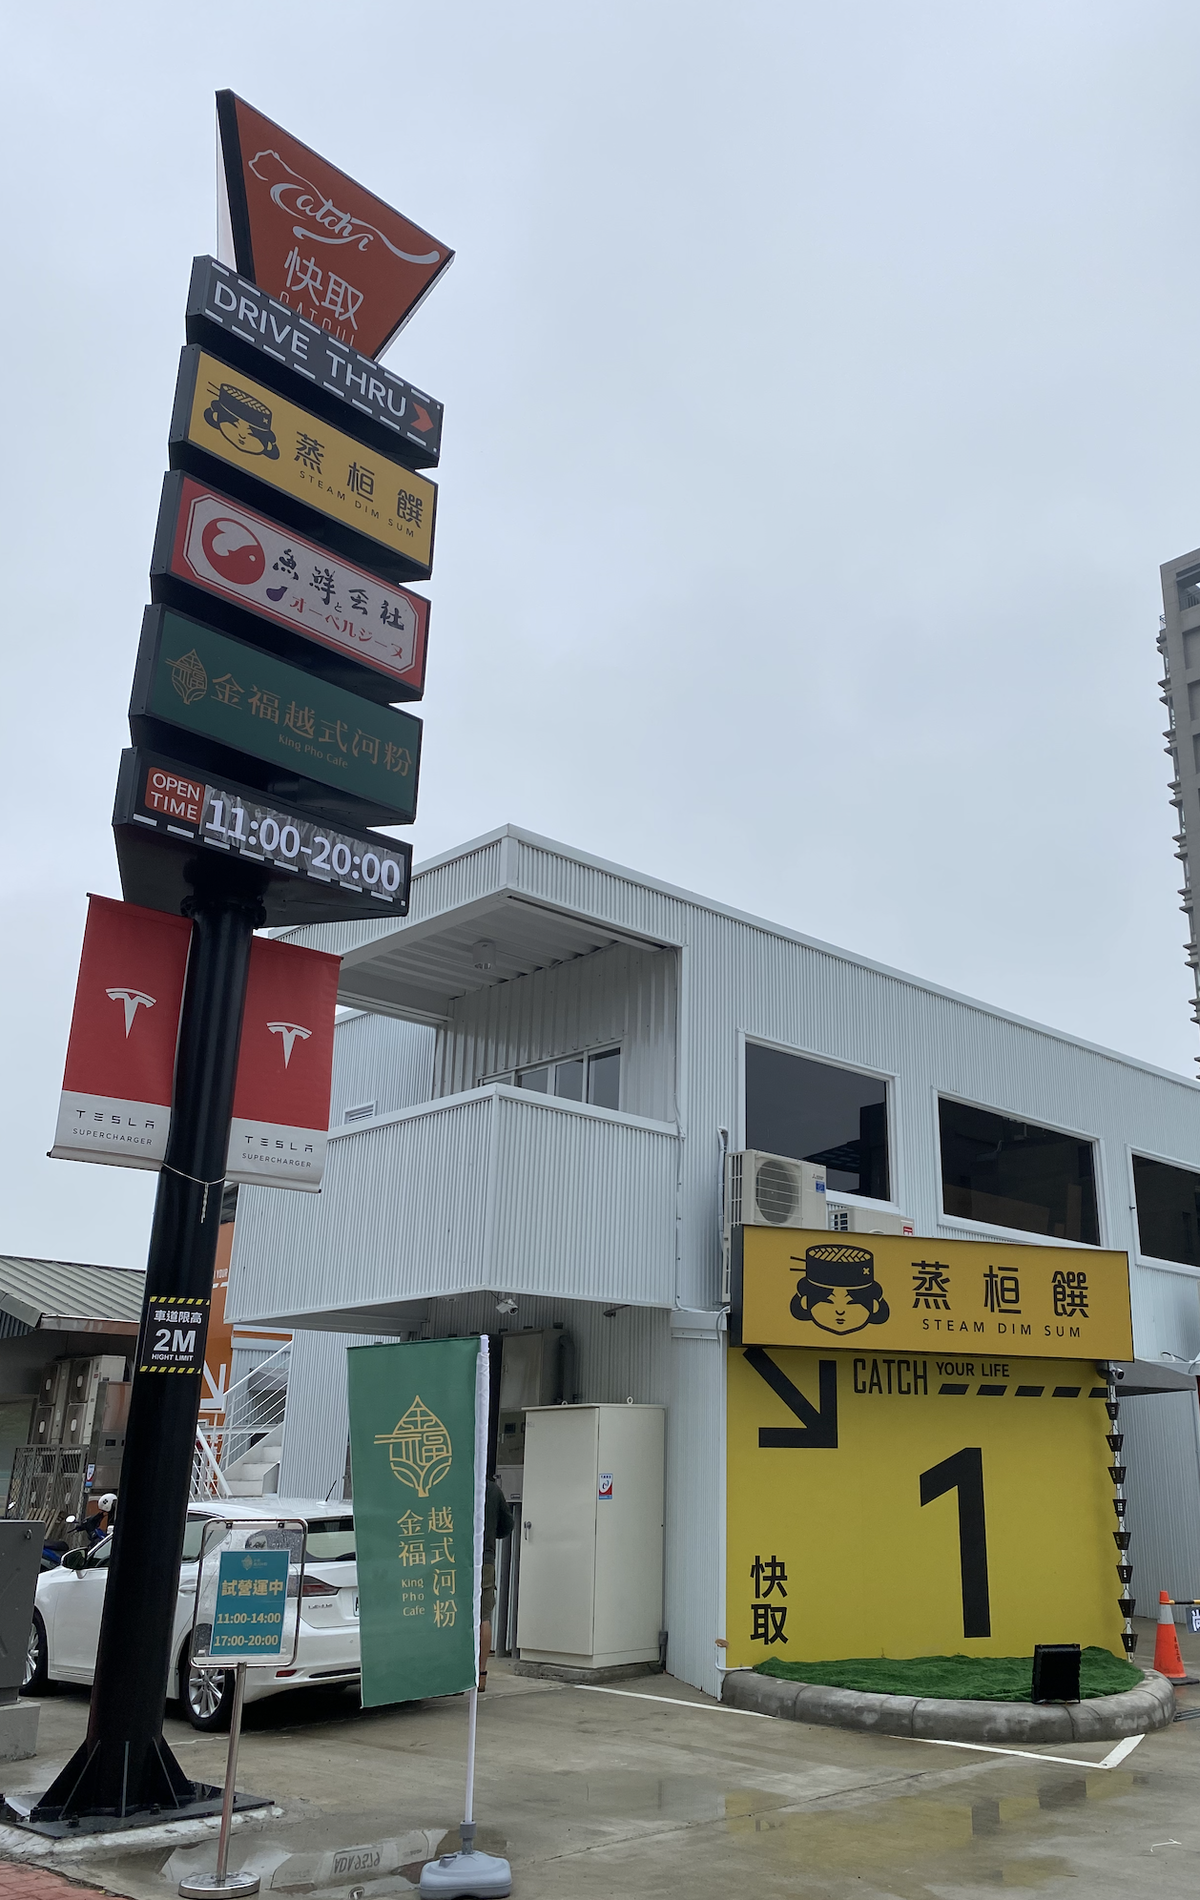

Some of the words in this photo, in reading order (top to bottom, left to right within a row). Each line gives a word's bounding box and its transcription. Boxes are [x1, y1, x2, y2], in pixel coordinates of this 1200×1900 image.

[284, 246, 364, 331] 快取
[213, 280, 310, 360] DRIVE
[325, 349, 407, 417] THRU
[293, 430, 424, 529] 蒸桓饌
[300, 470, 346, 501] STEAM
[354, 500, 380, 519] DIM
[388, 518, 415, 538] SUM
[210, 672, 413, 777] 金福越式河粉
[278, 733, 301, 752] King
[304, 744, 324, 760] Pho
[326, 752, 348, 769] Cafe
[152, 773, 200, 801] OPEN
[150, 790, 198, 821] TIME
[205, 799, 401, 892] 11:00-20:00
[76, 1109, 155, 1129] TESLA
[72, 1127, 153, 1146] SUPERCHARGER
[245, 1135, 313, 1153] TESLA
[242, 1152, 312, 1168] SUPERCHARGER
[911, 1260, 1090, 1318] 蒸桓饌
[153, 1309, 203, 1325] 車道限高
[922, 1318, 985, 1333] STEAM
[998, 1322, 1032, 1335] DIM
[1044, 1325, 1081, 1338] SUM
[153, 1328, 197, 1353] 2M
[151, 1353, 174, 1362] HIGHT
[175, 1354, 194, 1362] LIMIT
[853, 1358, 929, 1396] CATCH
[935, 1361, 975, 1377] YOUR
[981, 1363, 1010, 1378] LIFE
[396, 1509, 427, 1567] 金福
[920, 1447, 991, 1638] 1
[427, 1506, 458, 1629] 越式河粉
[221, 1579, 284, 1597] 試營運中
[401, 1578, 424, 1588] King
[402, 1591, 425, 1602] Pho
[402, 1605, 426, 1617] Cafe
[749, 1555, 789, 1646] 快取
[216, 1612, 281, 1624] 11:00-14:00
[213, 1635, 279, 1647] 17:00-20:00
